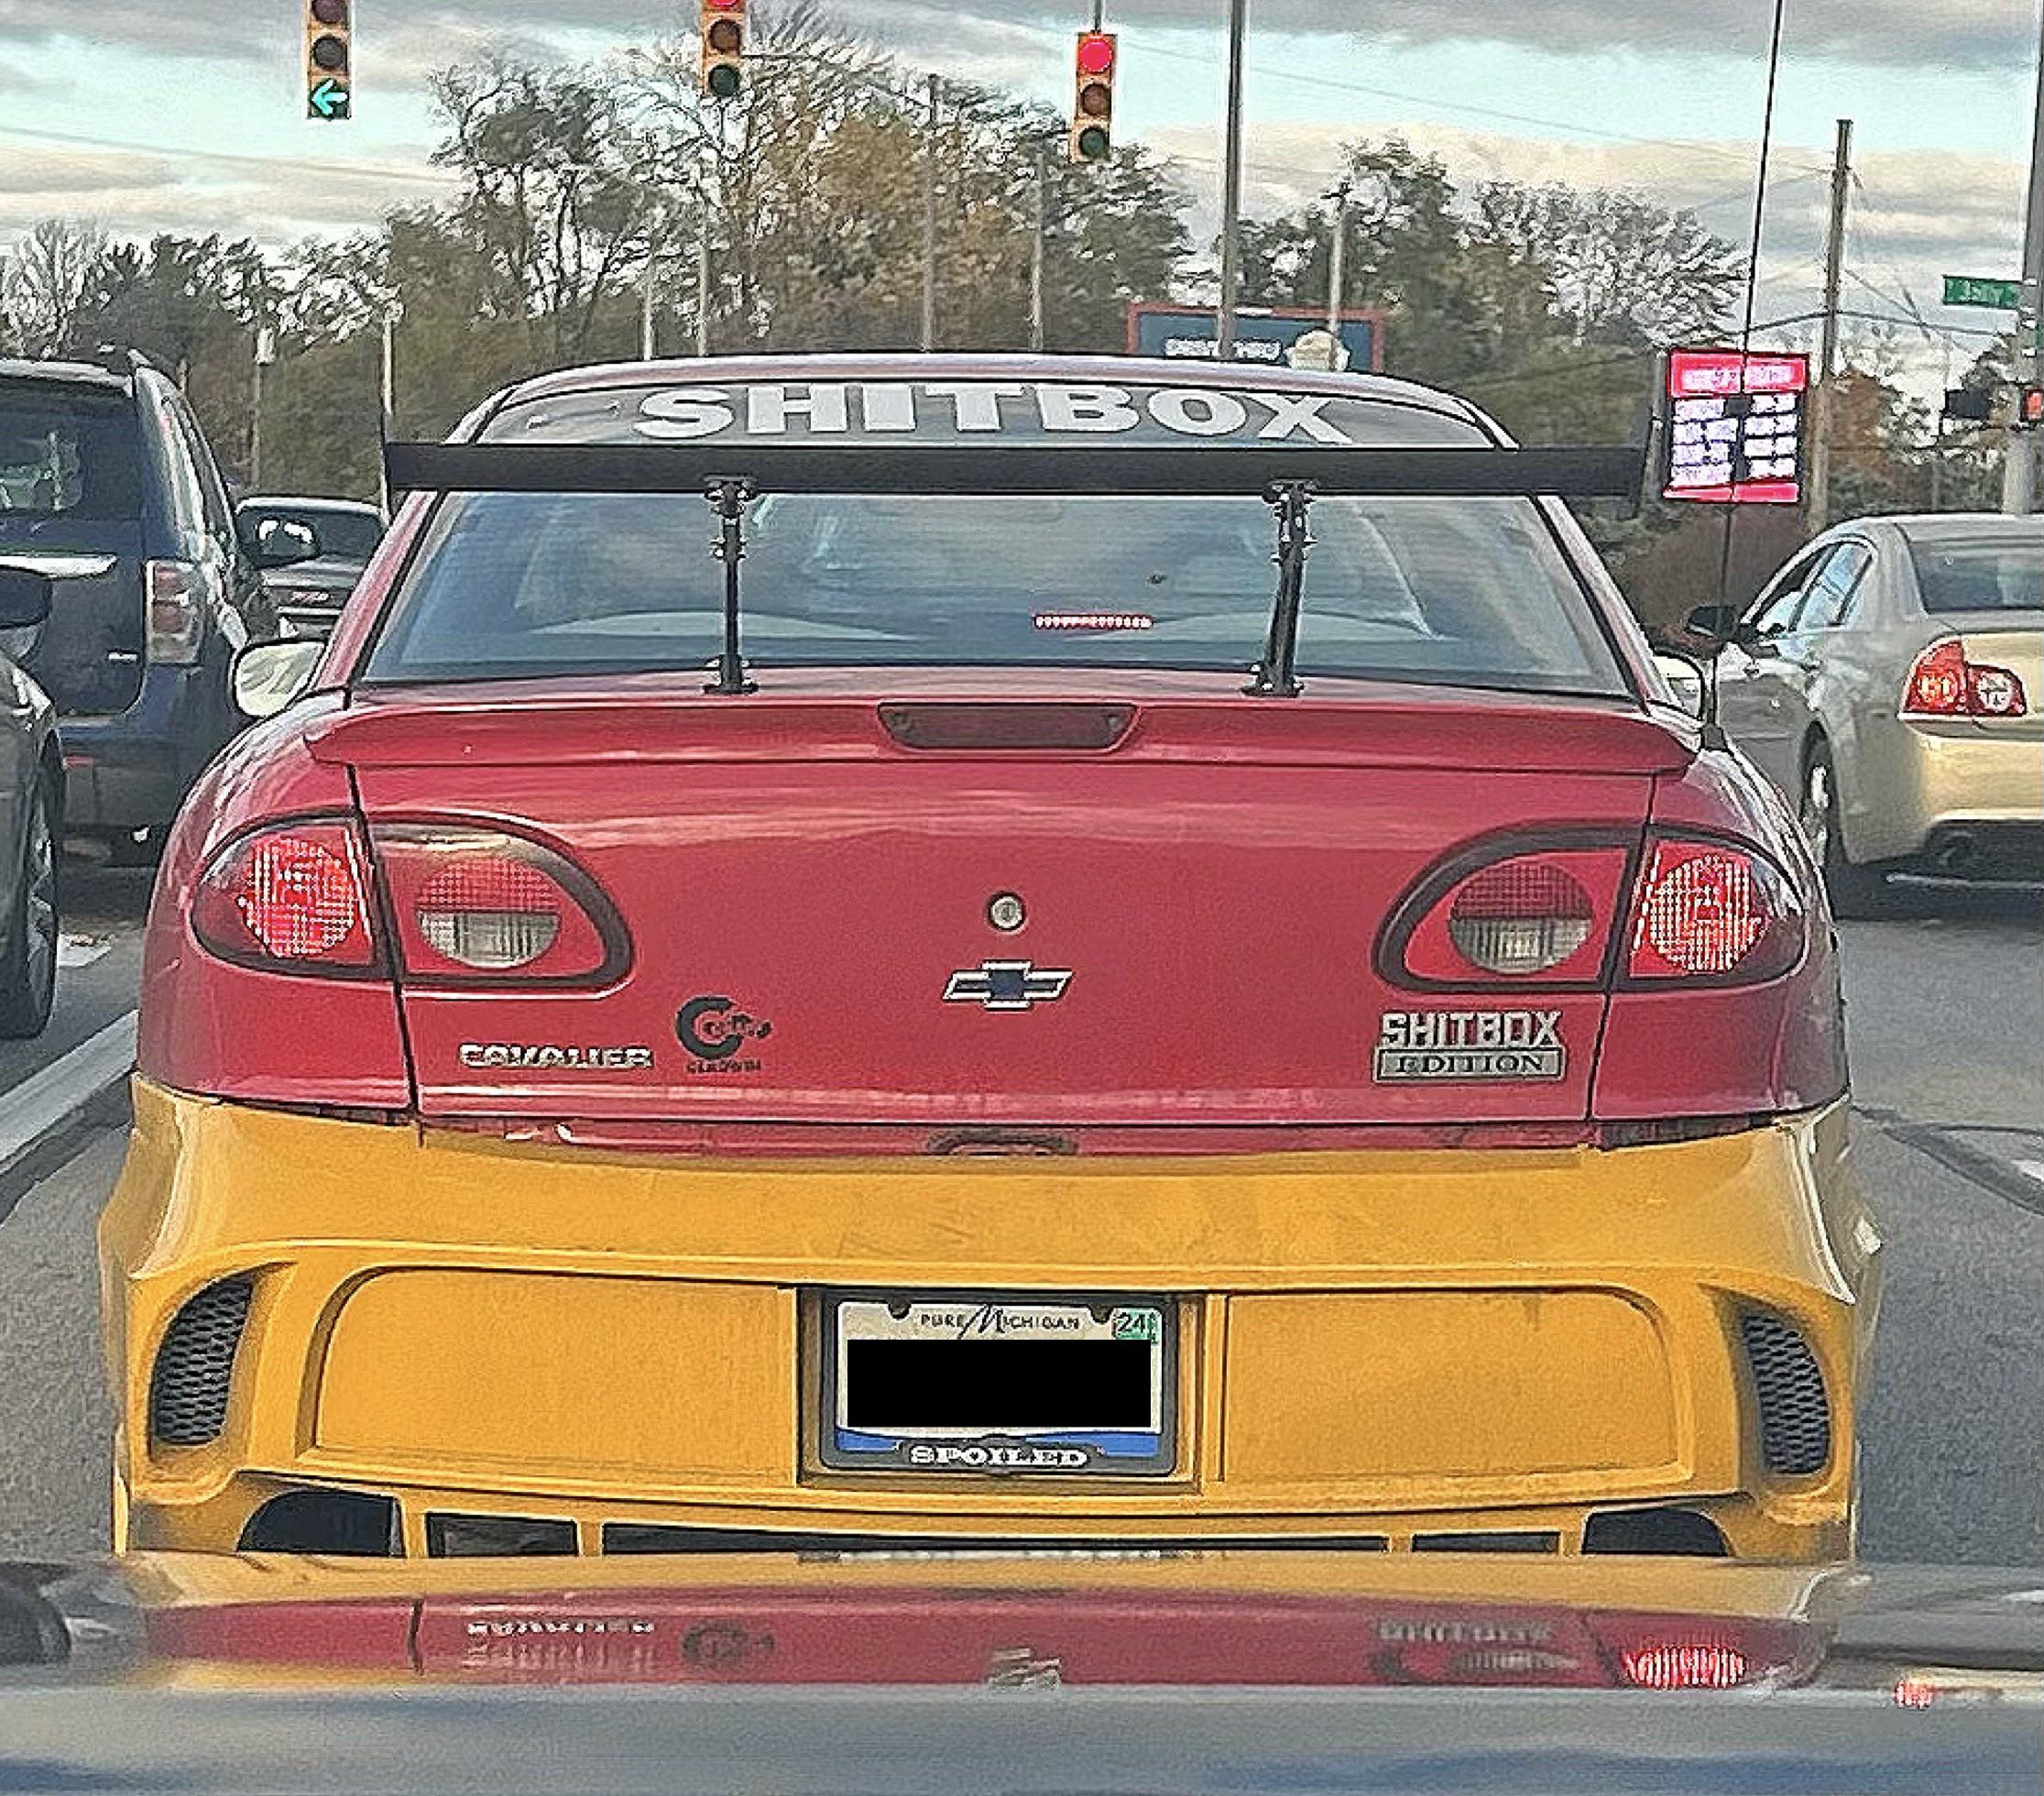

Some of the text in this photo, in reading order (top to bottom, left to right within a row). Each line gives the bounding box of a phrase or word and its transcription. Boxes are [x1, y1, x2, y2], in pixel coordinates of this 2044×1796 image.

[632, 381, 1354, 445] SHITBOX
[1381, 1011, 1562, 1047] SHITBOX
[459, 1043, 653, 1068] CAVALIER
[1395, 1056, 1544, 1074] EDITION
[920, 1304, 1080, 1339] PURE MICHIGAN
[1116, 1312, 1146, 1334] 24
[910, 1445, 1088, 1467] SPOILED
